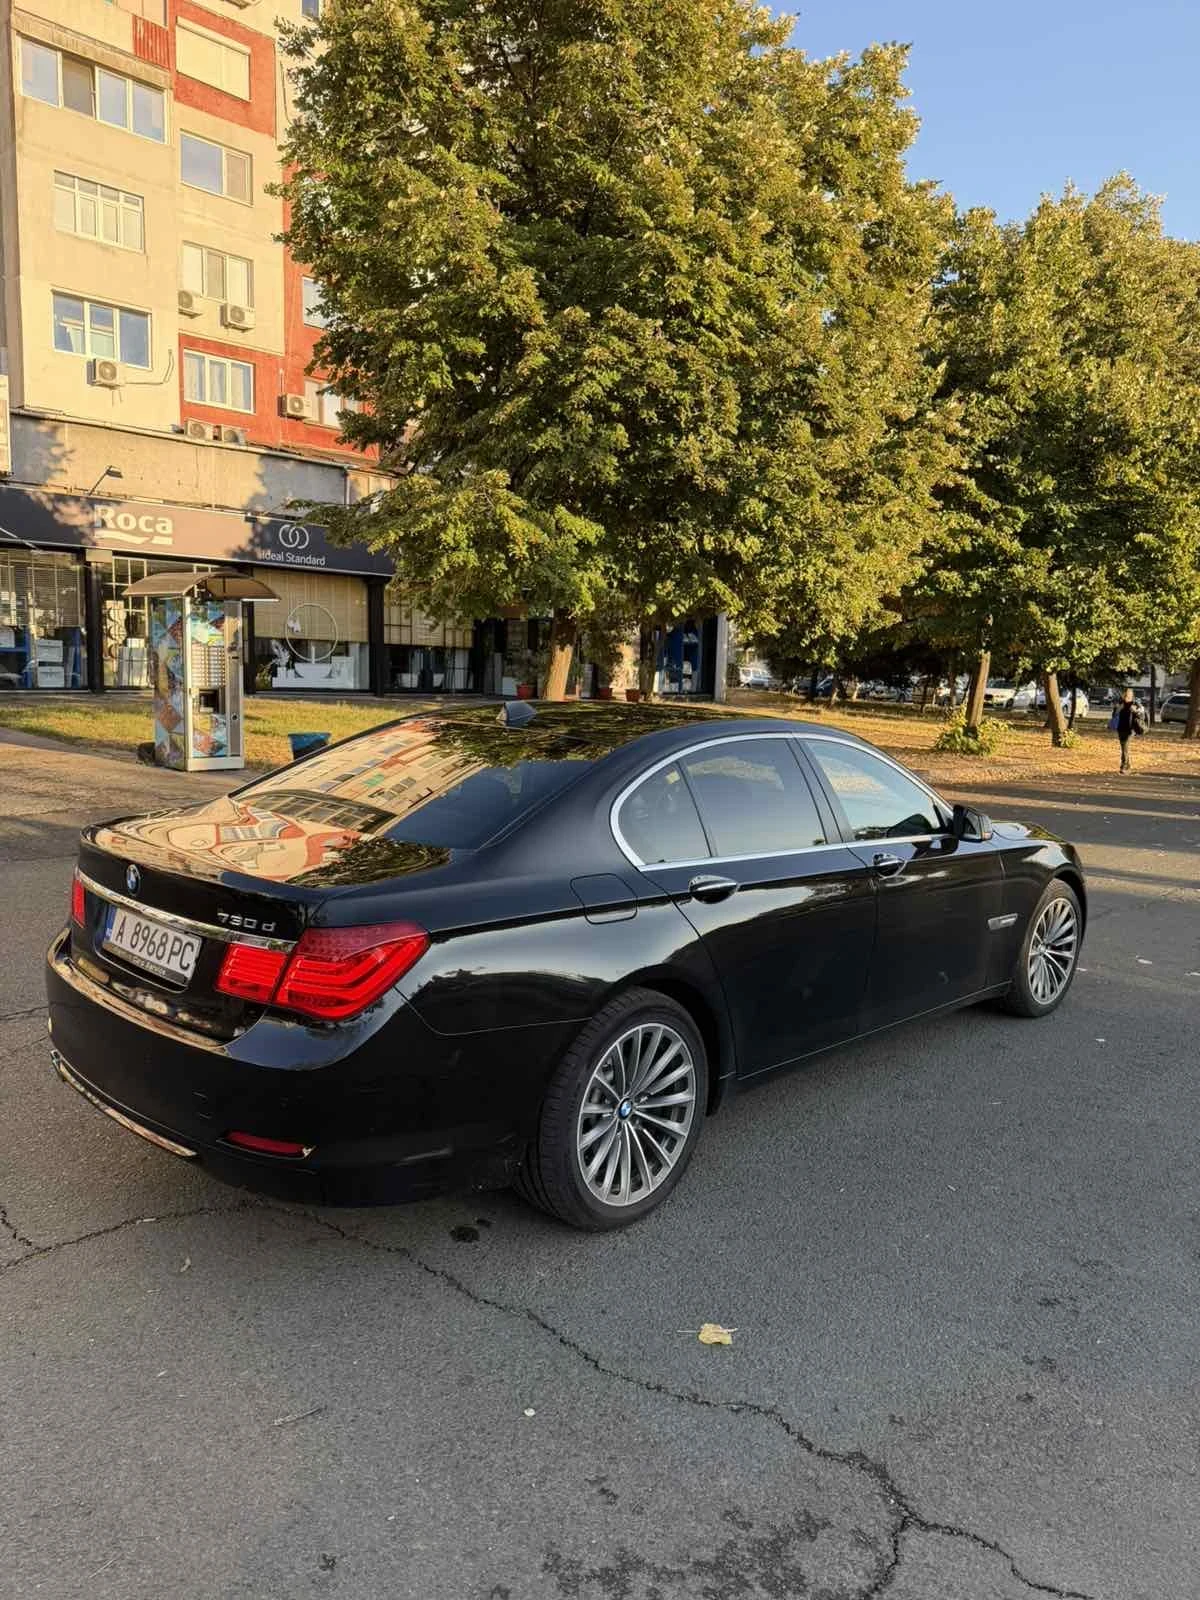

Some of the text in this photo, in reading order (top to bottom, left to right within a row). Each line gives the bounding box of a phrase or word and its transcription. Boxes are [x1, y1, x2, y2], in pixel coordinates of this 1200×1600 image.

[94, 505, 173, 534] Roca
[262, 550, 326, 566] Ideal Standard
[217, 913, 276, 932] 730 d
[115, 915, 126, 944] A
[130, 921, 169, 961] 8968
[167, 936, 194, 971] PC
